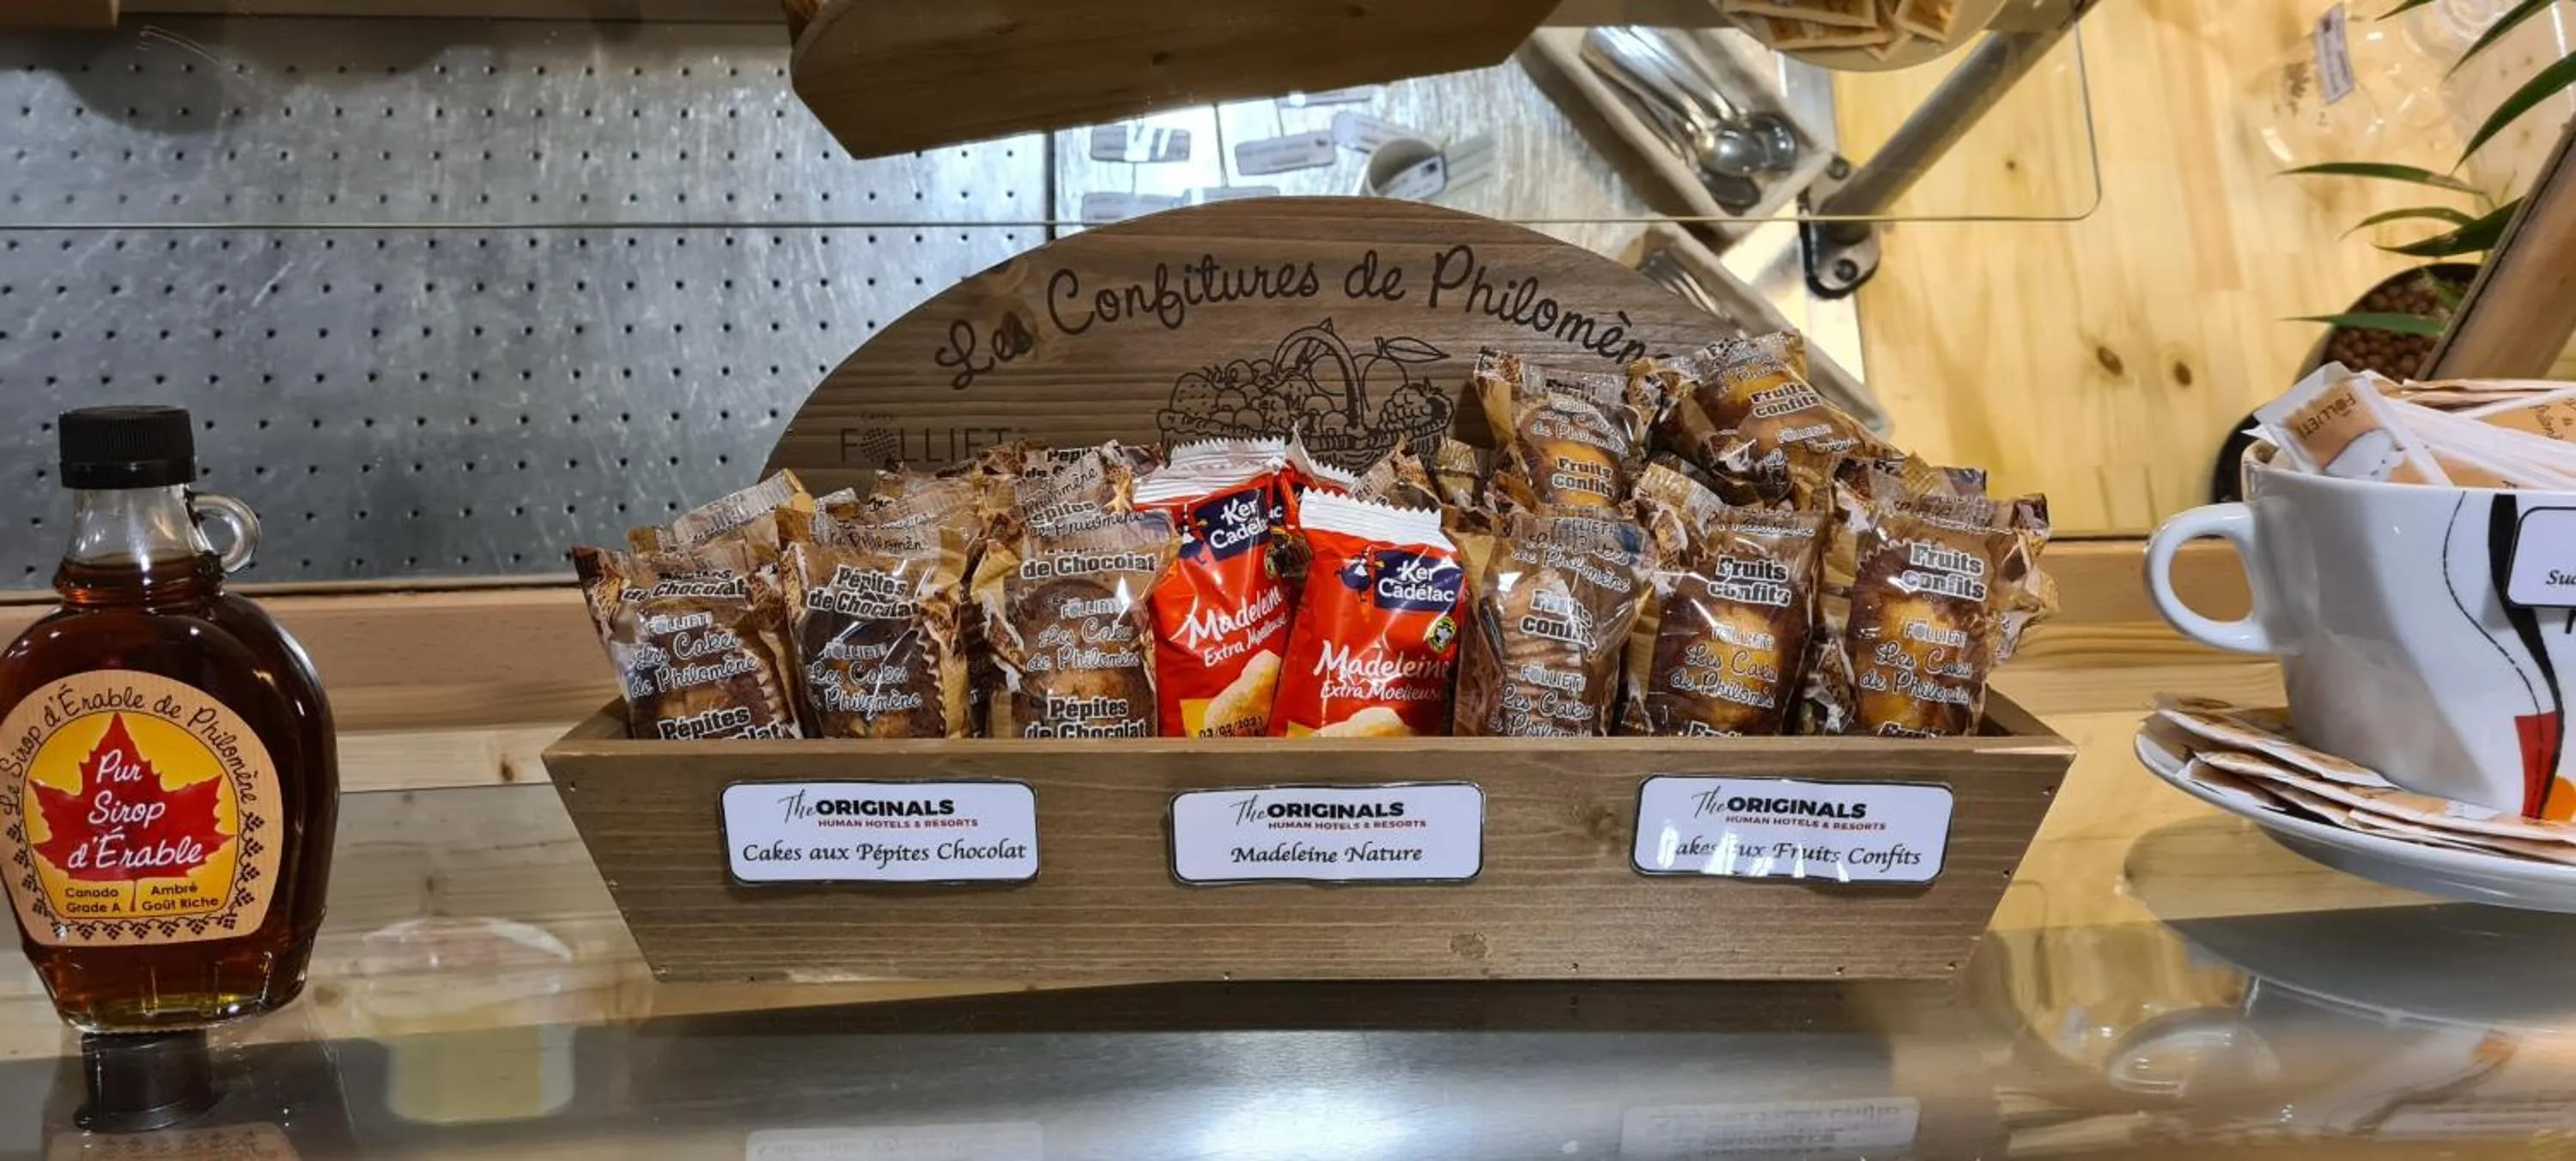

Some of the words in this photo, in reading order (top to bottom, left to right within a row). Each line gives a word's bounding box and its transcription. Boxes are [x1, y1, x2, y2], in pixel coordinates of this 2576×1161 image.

[934, 310, 1032, 390] Les
[1047, 254, 1320, 335] Confitures
[1345, 249, 1406, 301] de
[1429, 245, 1671, 367] Philomèn
[1750, 383, 1810, 404] Fruits
[1557, 456, 1614, 481] Fruits
[1220, 497, 1258, 526] Ker
[1021, 558, 1055, 579] de
[1056, 552, 1157, 576] Chocolat
[1396, 559, 1435, 584] Ker
[1716, 555, 1789, 582] Fruits
[1910, 541, 1984, 576] Fruits
[652, 576, 746, 598] Chocolat
[836, 564, 908, 594] Pépites
[1378, 577, 1455, 603] Cadélac
[807, 591, 834, 611] de
[834, 593, 920, 618] Chocolat
[1708, 581, 1791, 606] confits
[1203, 641, 1245, 668] Extra
[1313, 640, 1450, 681] Madeleine
[1321, 679, 1364, 700] Extra
[1047, 695, 1129, 721] Pépites
[658, 706, 750, 739] Pépites
[1025, 720, 1051, 738] de
[1051, 719, 1147, 738] Chocolat
[0, 725, 43, 778] Sirop
[44, 684, 146, 724] d'Érable
[153, 695, 182, 720] de
[186, 706, 259, 805] Philomène
[96, 749, 144, 783] Pur
[88, 790, 167, 826] Sirop
[778, 789, 816, 824] The
[816, 799, 955, 818] ORIGINALS
[1230, 793, 1267, 825] The
[1267, 802, 1404, 819] ORIGINALS
[1691, 786, 1726, 818] The
[1726, 796, 1867, 818] ORIGINALS
[818, 819, 861, 828] HUMAN
[865, 820, 911, 829] HOTELS
[924, 818, 979, 828] RESORTS
[1268, 821, 1312, 830] HUMAN
[1315, 821, 1361, 830] HOTELS
[1373, 820, 1427, 829] RESORTS
[1725, 816, 1770, 825] HUMAN
[1773, 818, 1820, 829] HOTELS
[1833, 822, 1886, 832] RESORTS
[68, 826, 204, 869] d'Érable
[743, 840, 803, 862] Cakes
[809, 848, 850, 861] aux
[856, 842, 930, 869] Pépites
[937, 838, 1027, 860] Chocolat
[1230, 842, 1338, 863] Madeleine
[1344, 842, 1424, 862] Nature
[1722, 845, 1764, 858] ux
[1771, 842, 1841, 864] Fruits
[1847, 843, 1922, 873] Confits
[64, 887, 119, 898] Canada
[150, 881, 198, 897] Ambré
[65, 902, 108, 913] Grade
[111, 903, 121, 912] A
[142, 897, 177, 913] Goût
[179, 897, 220, 909] Riche
